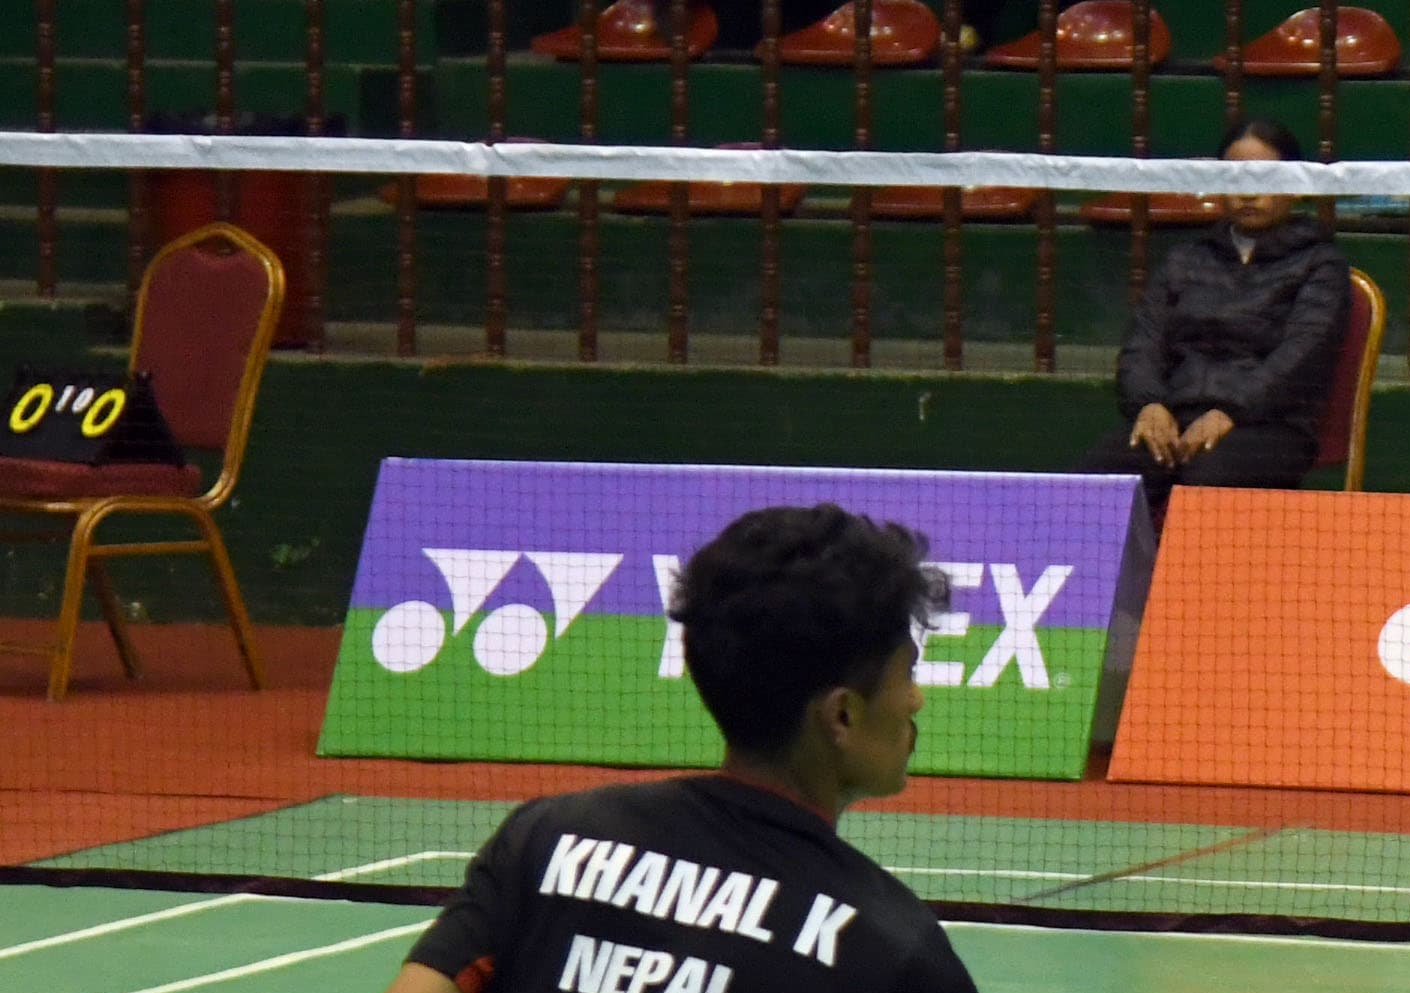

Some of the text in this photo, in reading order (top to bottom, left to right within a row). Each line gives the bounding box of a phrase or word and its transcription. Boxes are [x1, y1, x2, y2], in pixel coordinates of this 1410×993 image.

[10, 383, 54, 433] 0
[82, 388, 125, 438] 0
[652, 554, 1074, 689] YEX
[539, 833, 857, 968] KHANAL K
